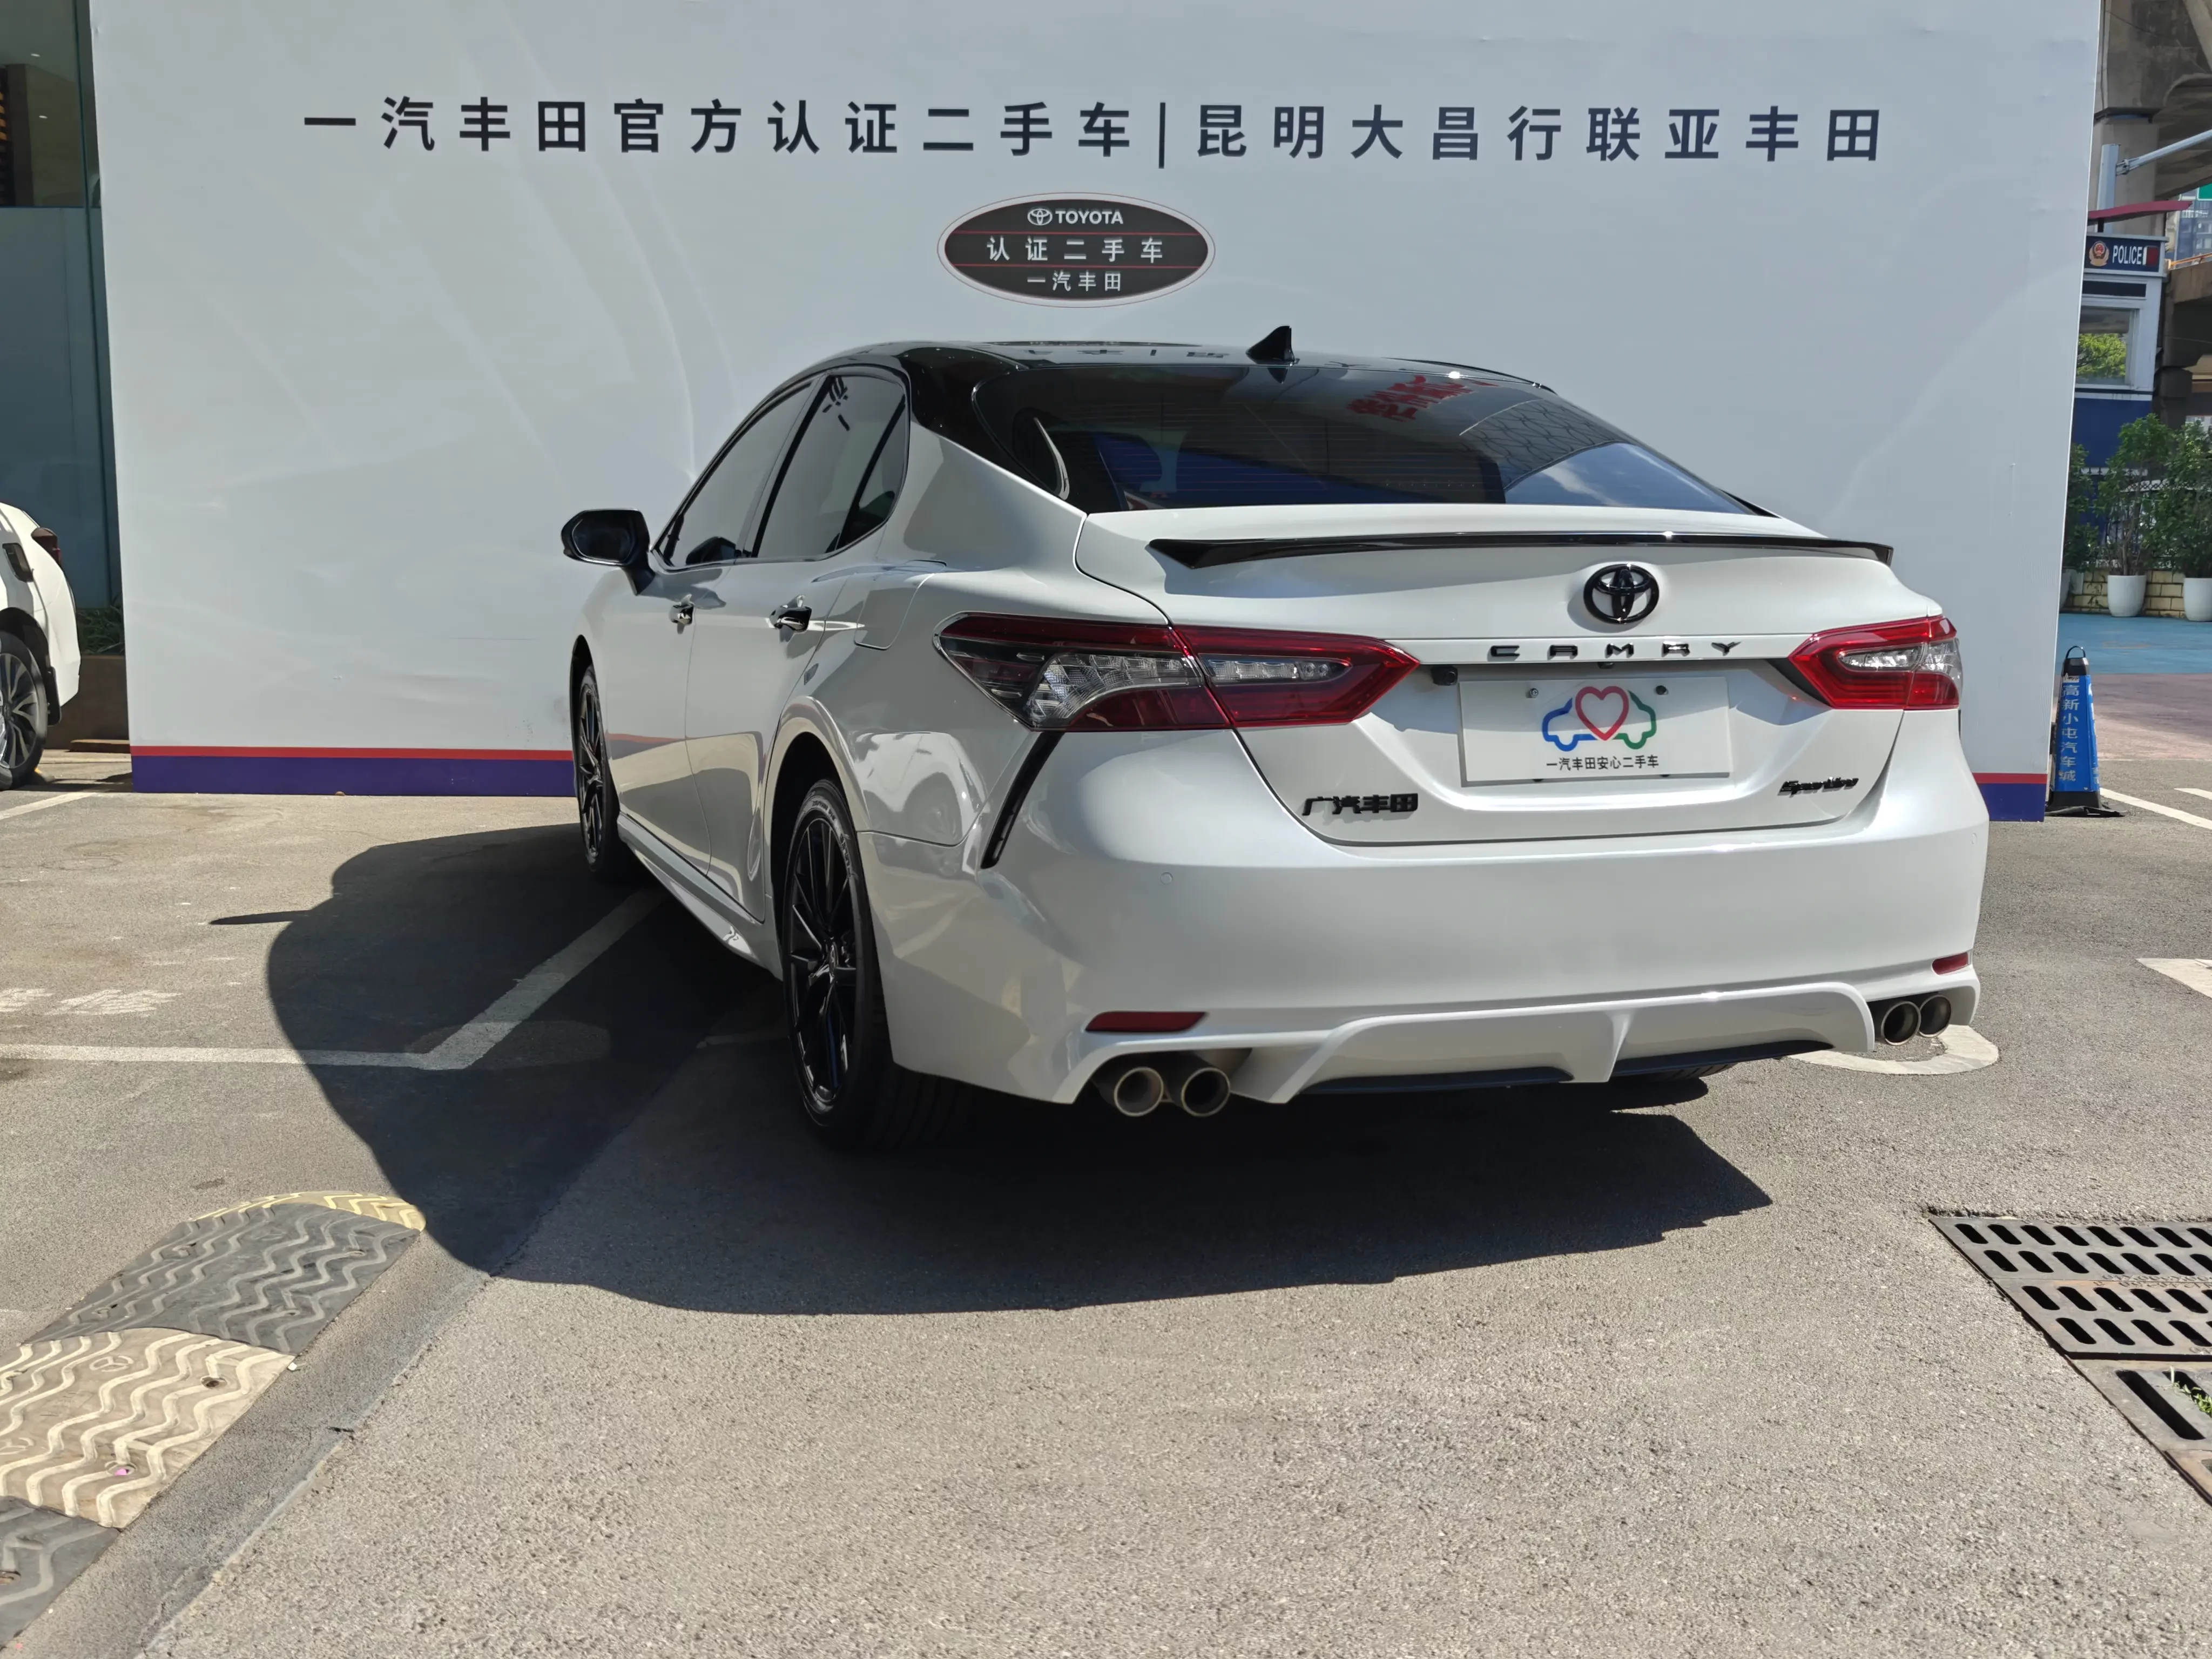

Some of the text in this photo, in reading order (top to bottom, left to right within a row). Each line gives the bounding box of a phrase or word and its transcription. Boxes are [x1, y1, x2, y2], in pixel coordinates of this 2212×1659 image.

[1055, 210, 1124, 224] TOYOTA
[987, 236, 1163, 264] 认证二手车
[2112, 245, 2143, 265] POLICE
[1027, 271, 1121, 292] 一汽丰田
[1491, 641, 1742, 658] CAMRY
[2060, 684, 2080, 781] 高新小屯汽车城
[1547, 754, 1659, 771] 一汽丰田安心二手车
[1301, 793, 1419, 816] 广汽丰田
